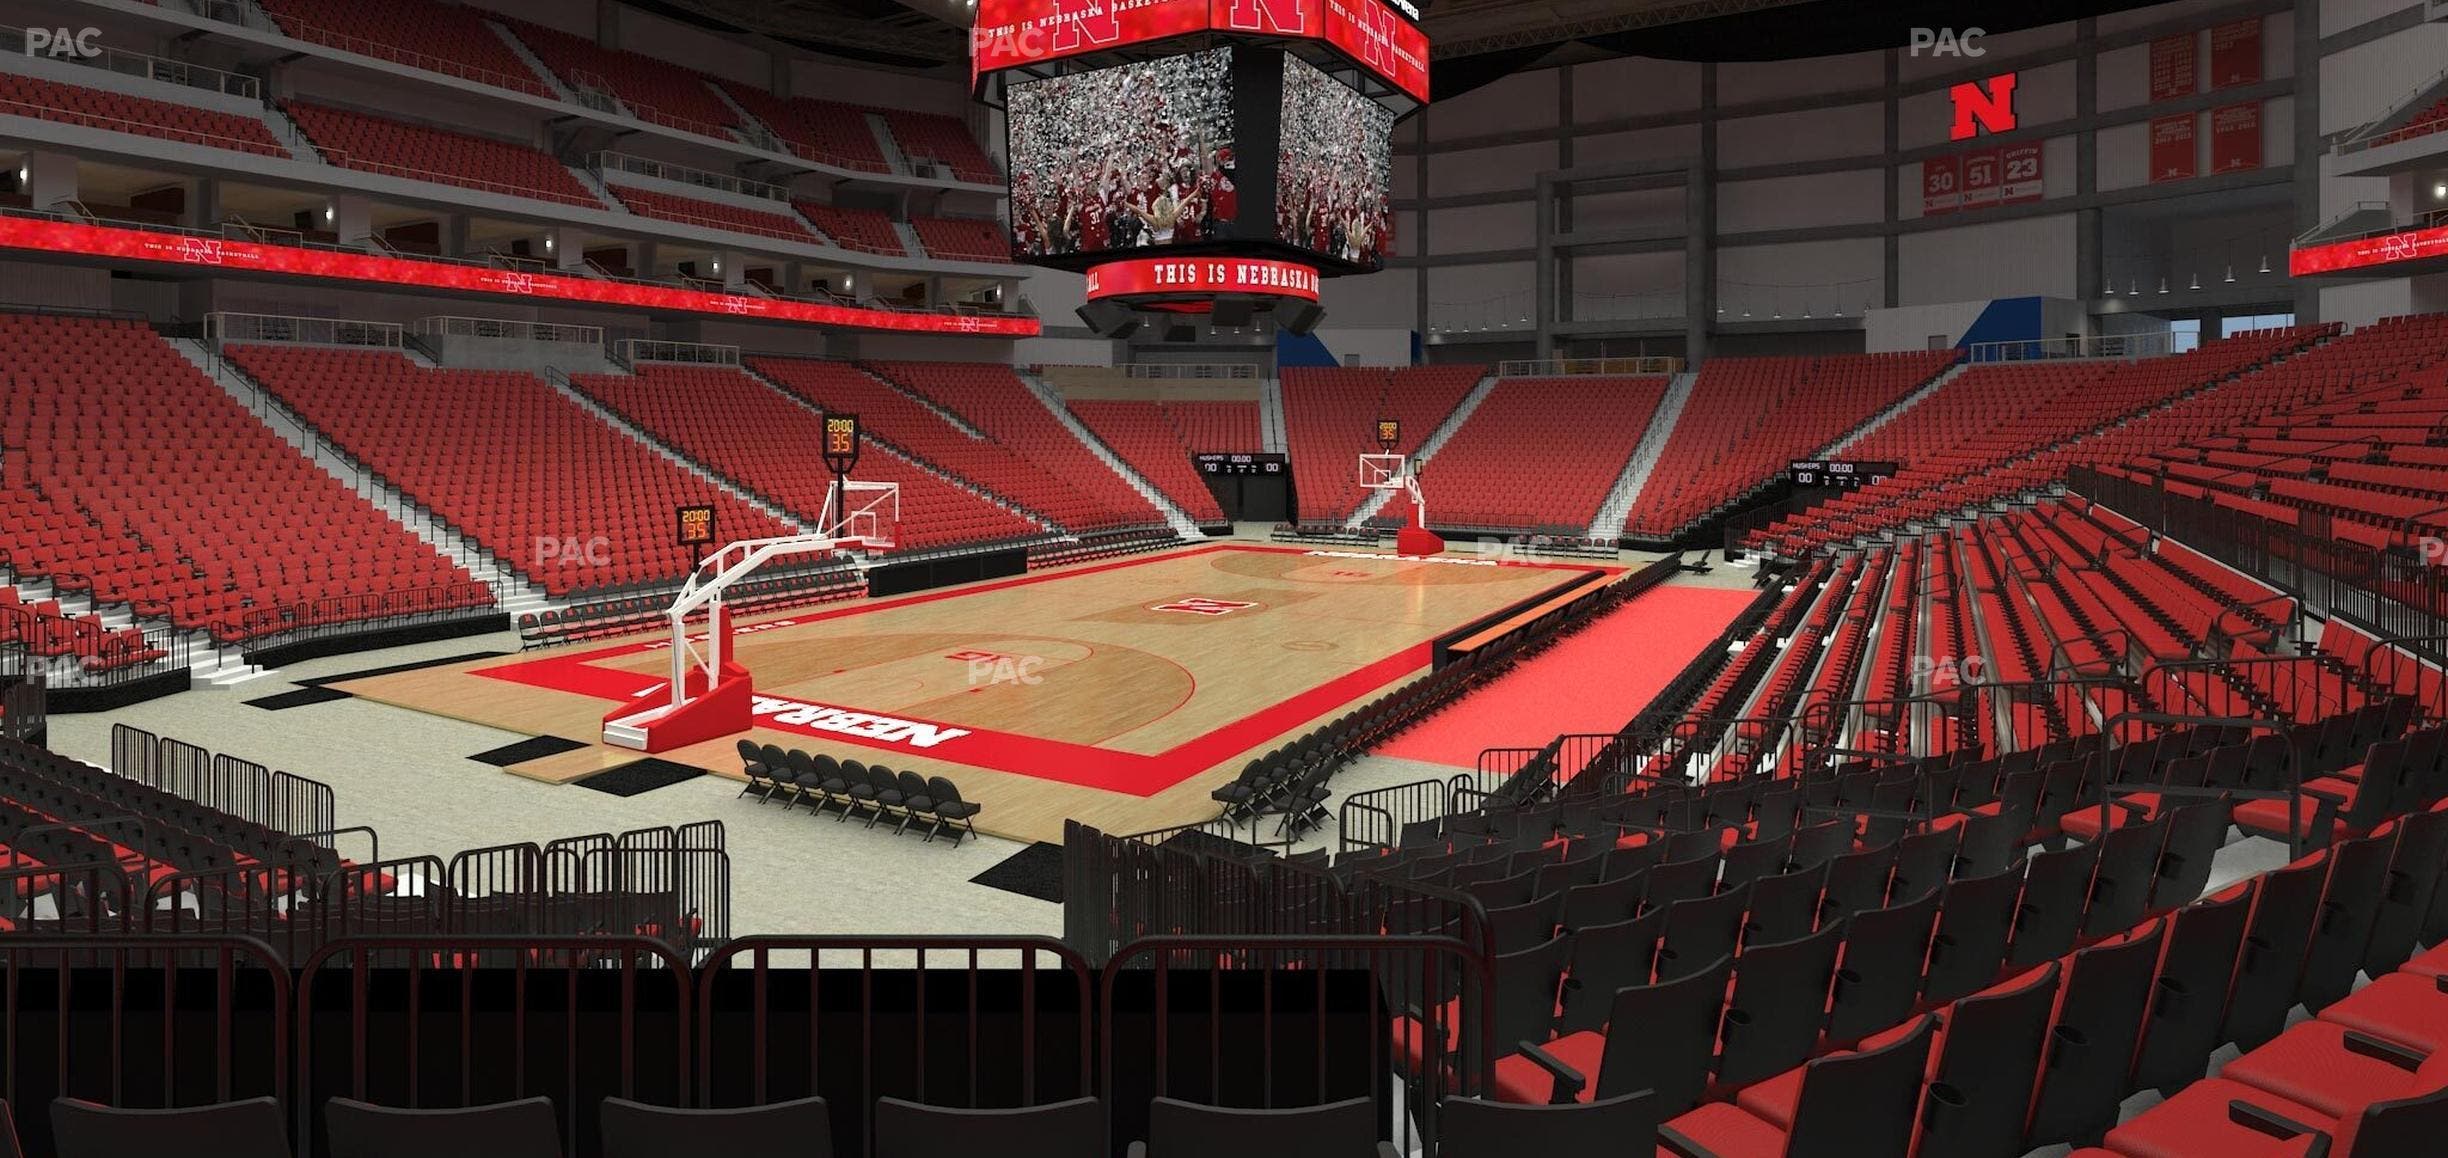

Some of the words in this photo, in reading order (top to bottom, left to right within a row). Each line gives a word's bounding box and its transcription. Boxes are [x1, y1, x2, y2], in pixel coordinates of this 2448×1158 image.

[988, 24, 1015, 38] THIS
[1021, 20, 1033, 32] IS
[1039, 6, 1103, 28] NEBRASKA
[1949, 72, 2017, 142] N
[1969, 164, 1992, 186] 51
[2006, 158, 2038, 180] 23
[1928, 172, 1953, 193] 30
[1154, 263, 1196, 284] THIS
[1208, 263, 1226, 284] IS
[1236, 264, 1309, 290] NEBRASKA
[827, 419, 854, 433] 20:00
[832, 433, 850, 452] 35
[1266, 463, 1279, 472] 00
[1792, 462, 1821, 470] HUSKERS
[1829, 463, 1853, 473] 00:00
[1798, 472, 1813, 484] 00
[682, 509, 711, 523] 20:00
[687, 522, 706, 540] 35
